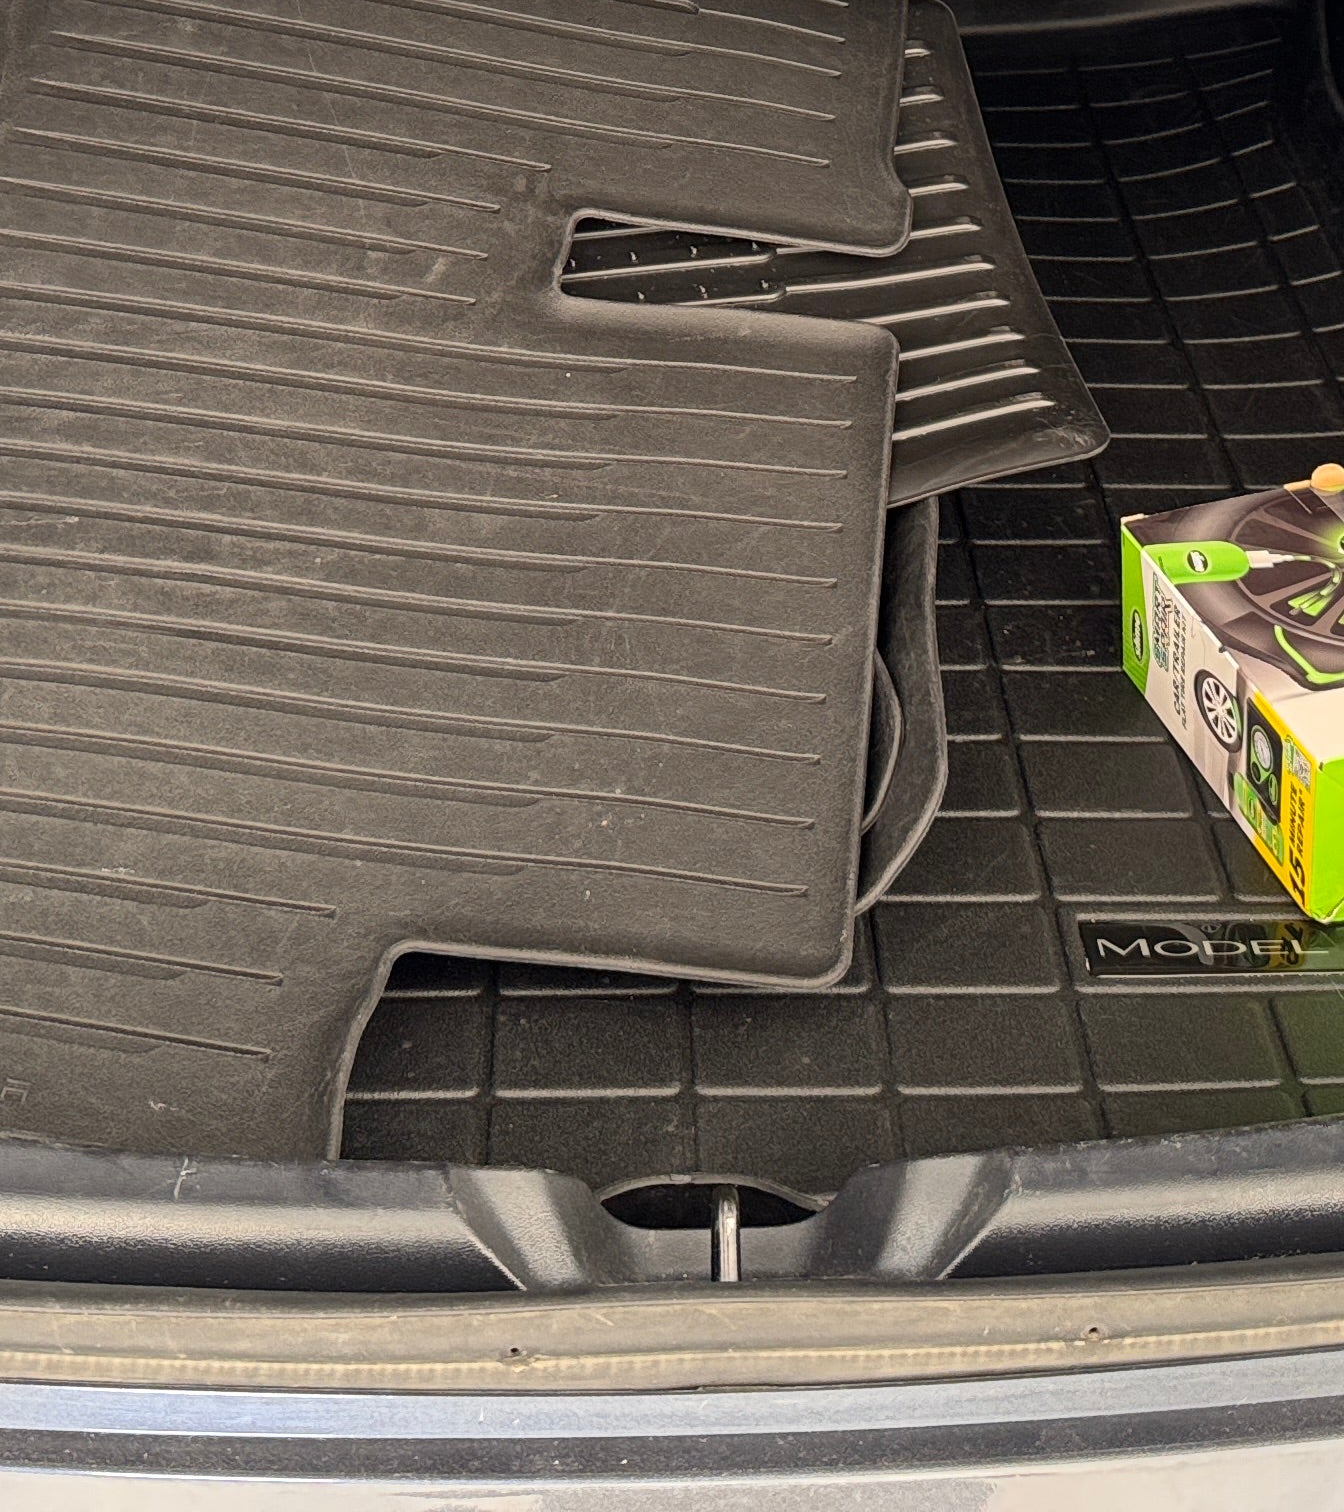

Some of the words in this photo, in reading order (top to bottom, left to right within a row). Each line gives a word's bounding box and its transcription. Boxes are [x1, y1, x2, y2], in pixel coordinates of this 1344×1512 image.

[1289, 782, 1298, 848] MINUTE
[1289, 845, 1306, 908] 15
[1096, 937, 1329, 958] MODEL
